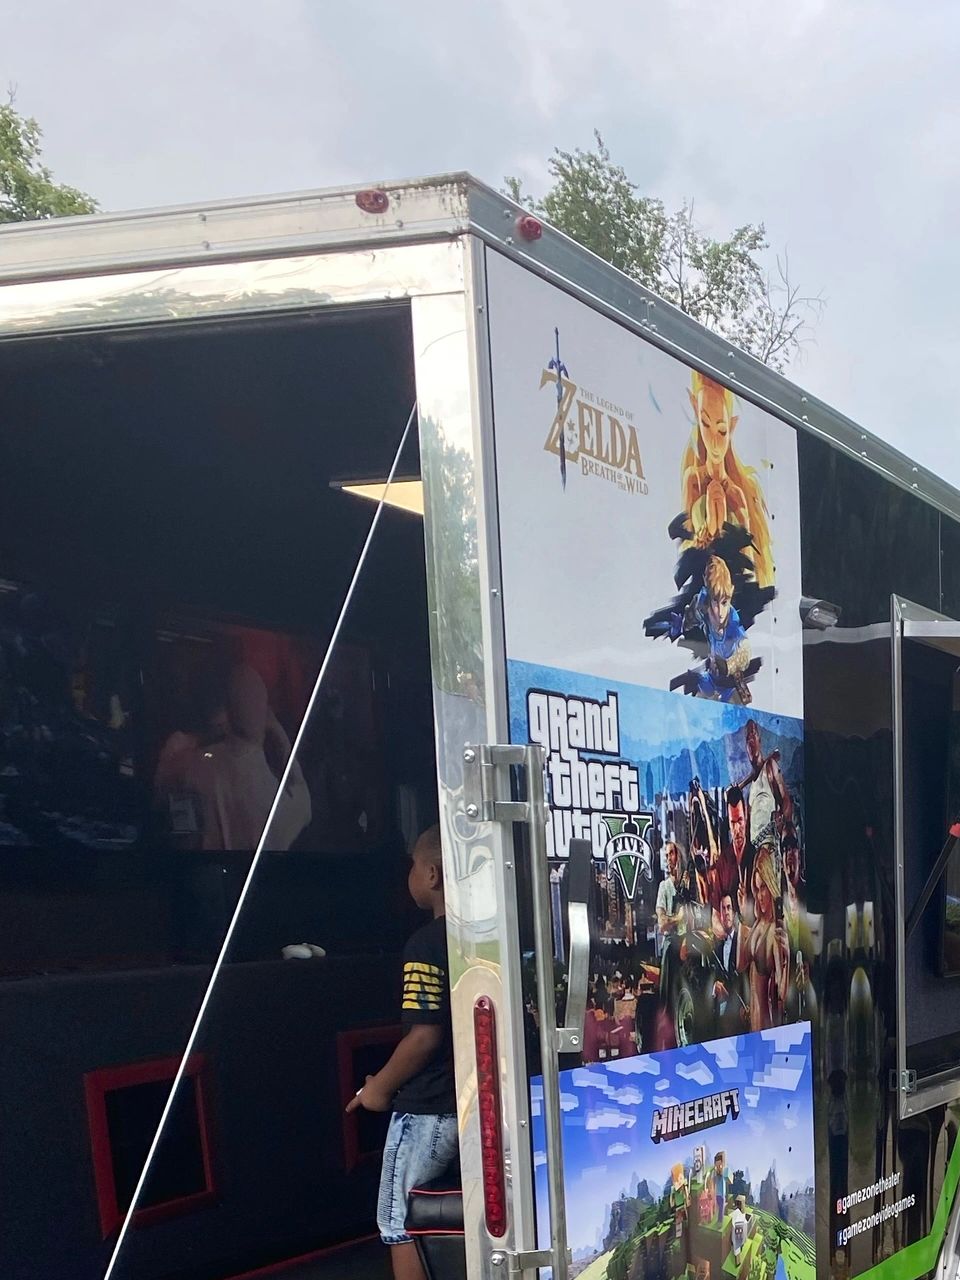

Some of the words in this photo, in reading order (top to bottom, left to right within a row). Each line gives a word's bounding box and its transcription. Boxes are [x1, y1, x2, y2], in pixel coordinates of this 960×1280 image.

[539, 367, 646, 480] ZELDA
[579, 385, 595, 403] THE
[596, 396, 625, 417] LEGEND
[624, 410, 635, 421] OF
[580, 456, 617, 483] BREATH
[625, 474, 649, 496] WILD
[612, 836, 645, 857] FIVE
[650, 1087, 741, 1141] MINECRAFT
[842, 1172, 901, 1215] gamezonetheater
[843, 1193, 916, 1246] gamezonevideogames
